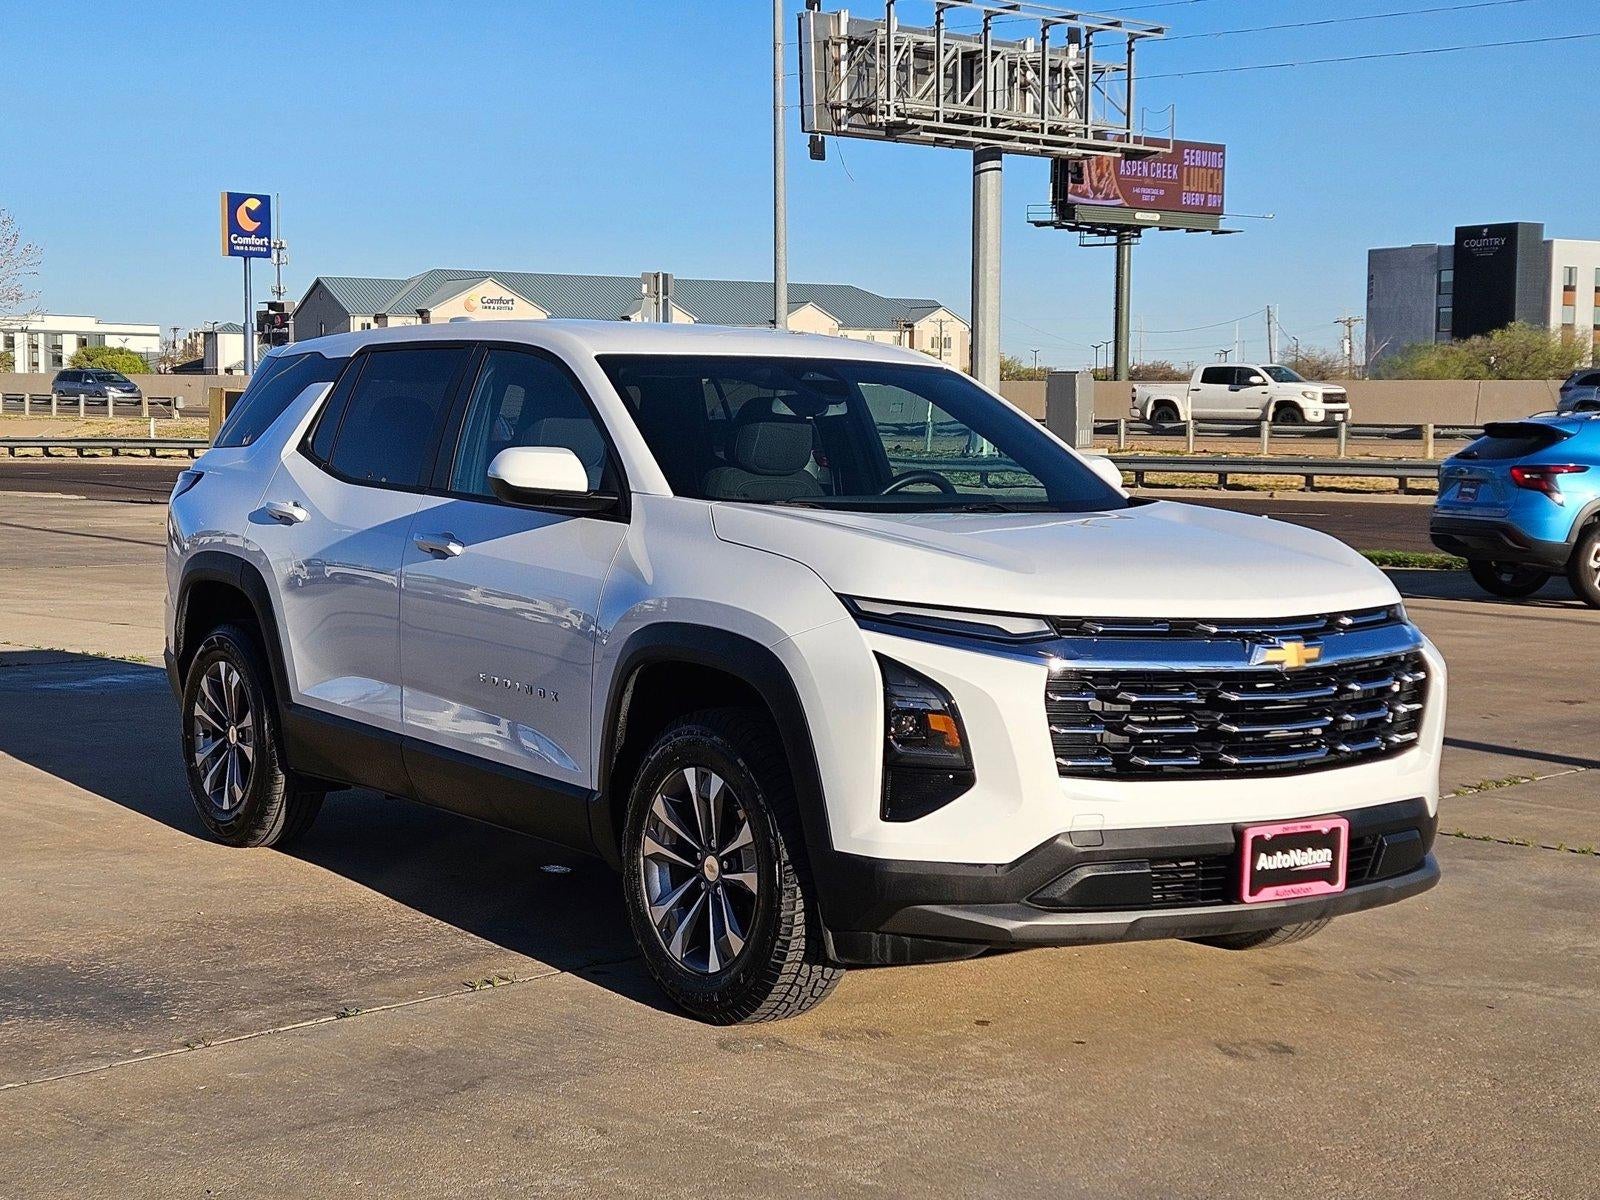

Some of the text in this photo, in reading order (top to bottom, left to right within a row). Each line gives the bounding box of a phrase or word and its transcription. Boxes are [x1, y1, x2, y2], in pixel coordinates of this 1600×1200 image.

[1183, 148, 1224, 169] SERVING
[1120, 159, 1179, 180] ASPEN CREEK
[1182, 166, 1223, 194] LUNCH
[1182, 192, 1222, 207] EVERY DAY
[230, 233, 269, 246] Comfort
[1463, 237, 1507, 248] COUNTRY
[480, 296, 515, 305] Comfort
[1255, 847, 1333, 871] AutoNation
